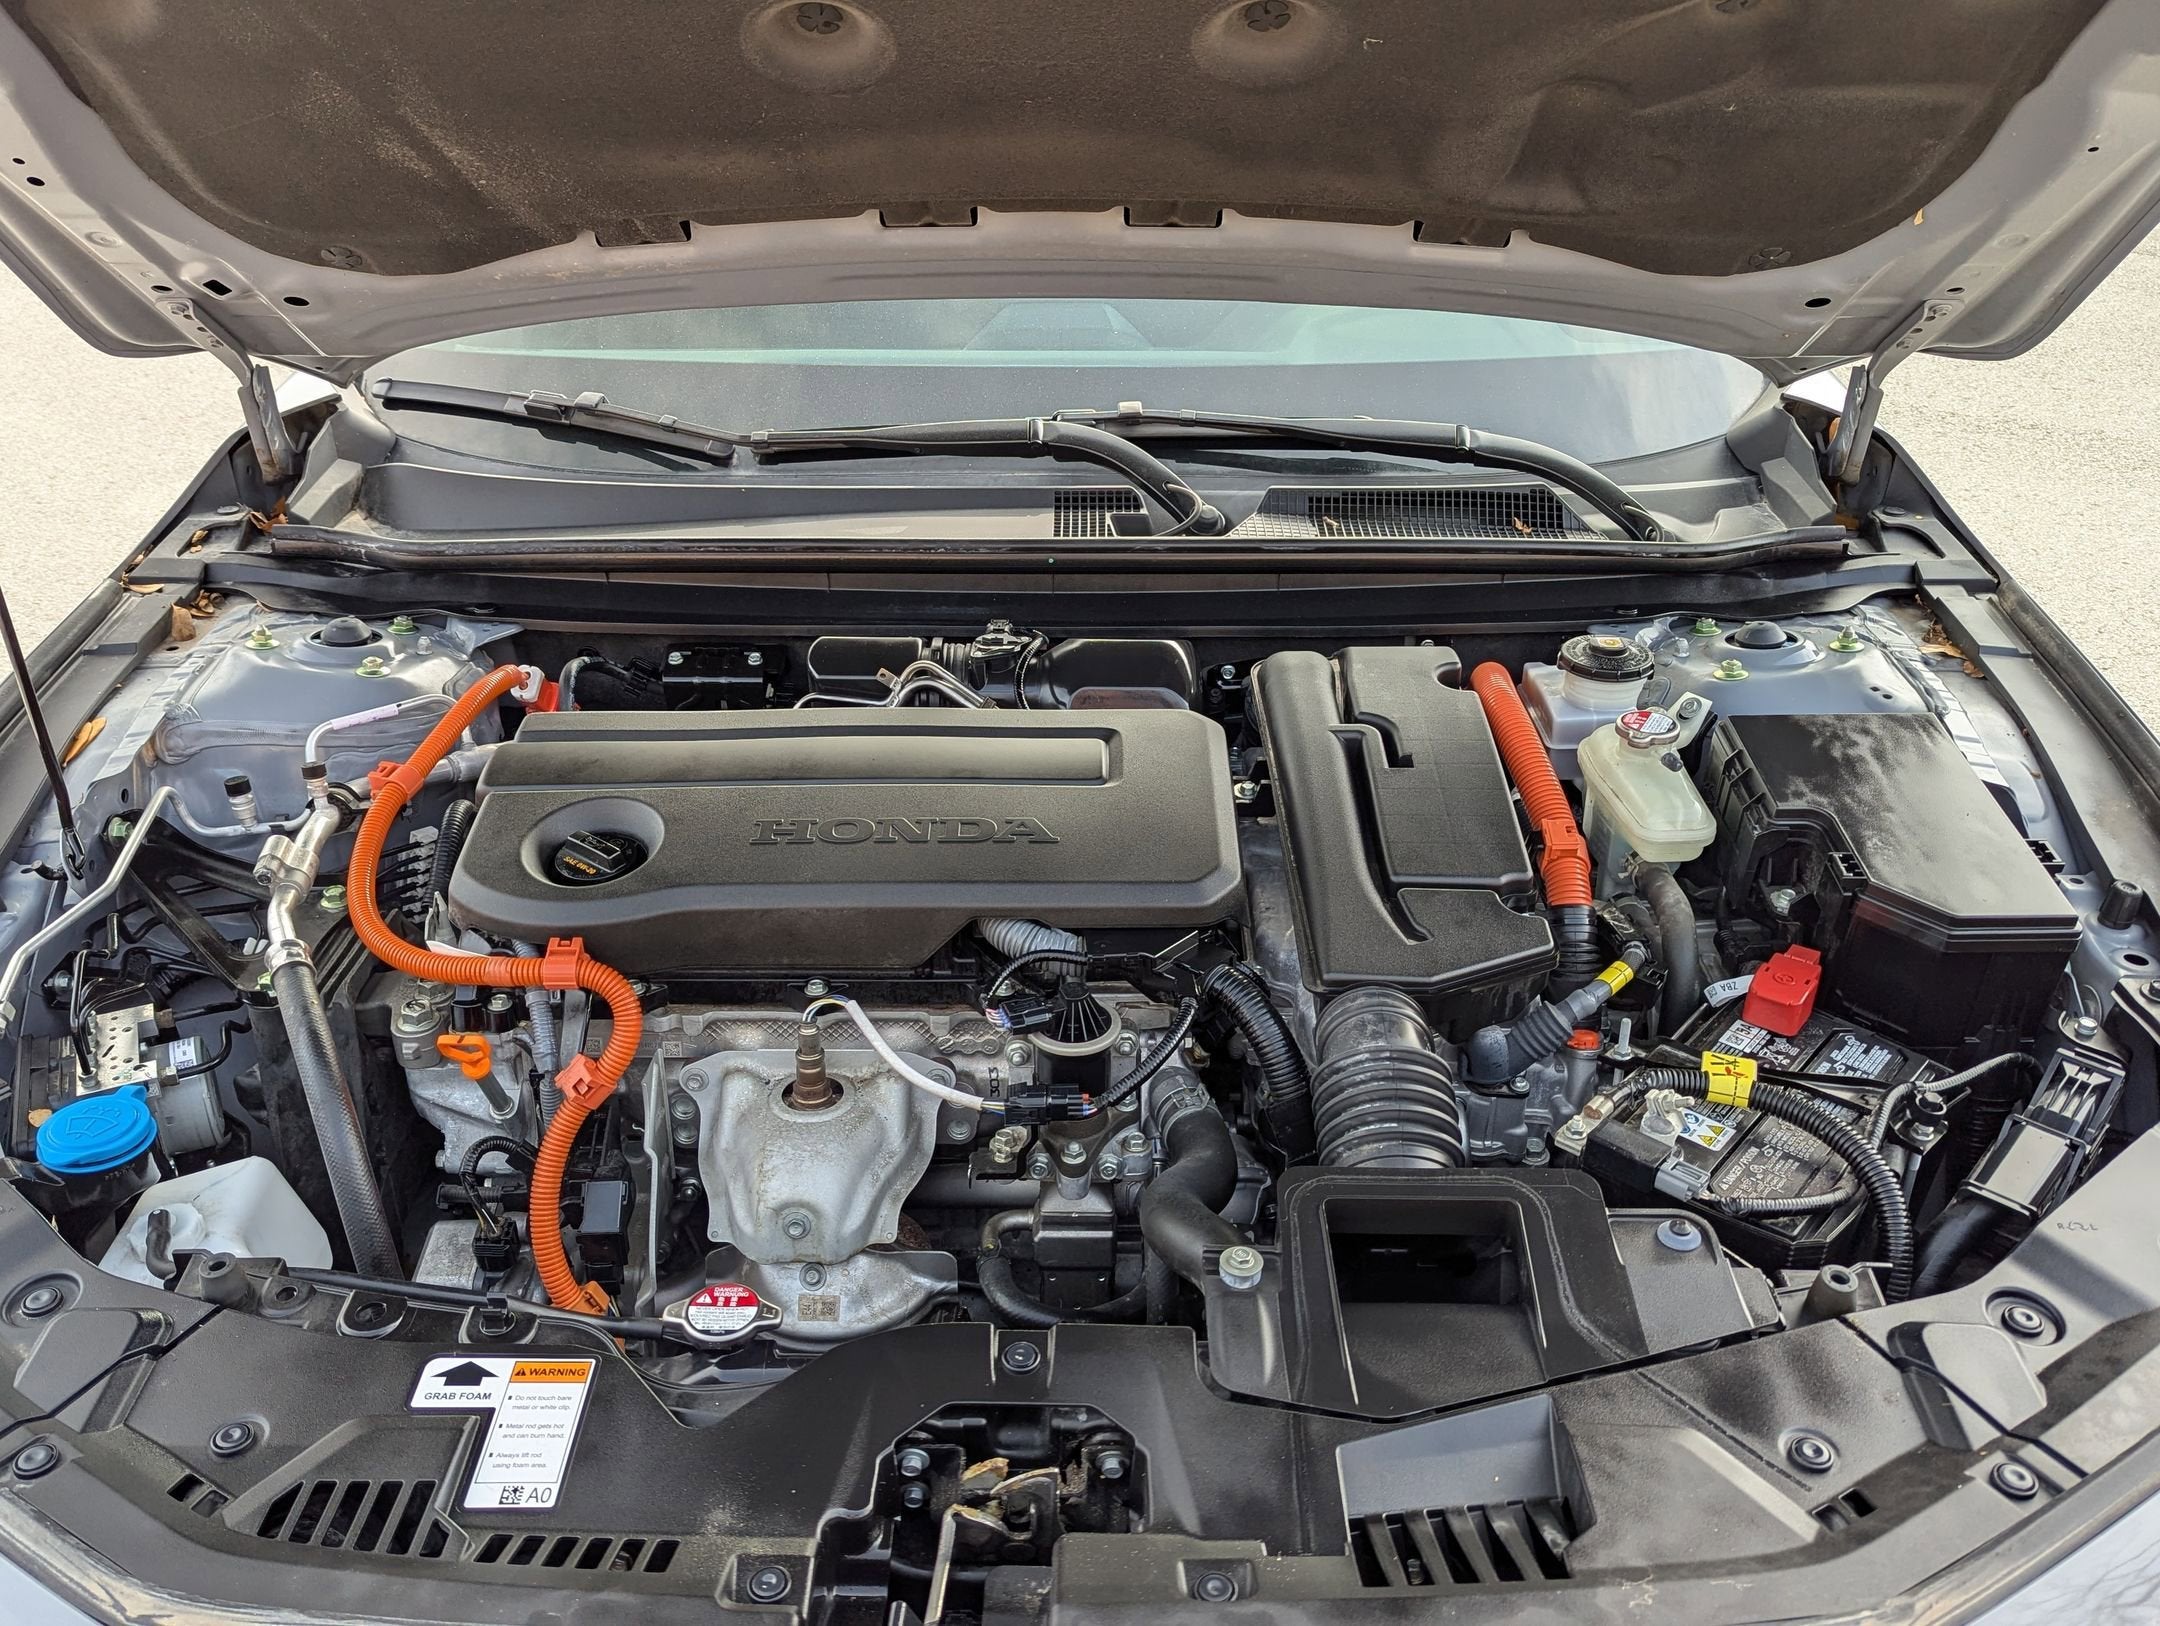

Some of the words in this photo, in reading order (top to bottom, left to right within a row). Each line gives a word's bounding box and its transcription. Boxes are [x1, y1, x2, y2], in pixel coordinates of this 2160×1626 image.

[748, 816, 1060, 845] HONDA
[563, 855, 577, 866] SAE
[576, 862, 597, 875] 0W-20
[1719, 981, 1739, 992] ZBA
[988, 1067, 1000, 1097] 303
[529, 1368, 586, 1377] WARNING
[424, 1392, 456, 1401] GRAB
[459, 1392, 492, 1400] FOAM
